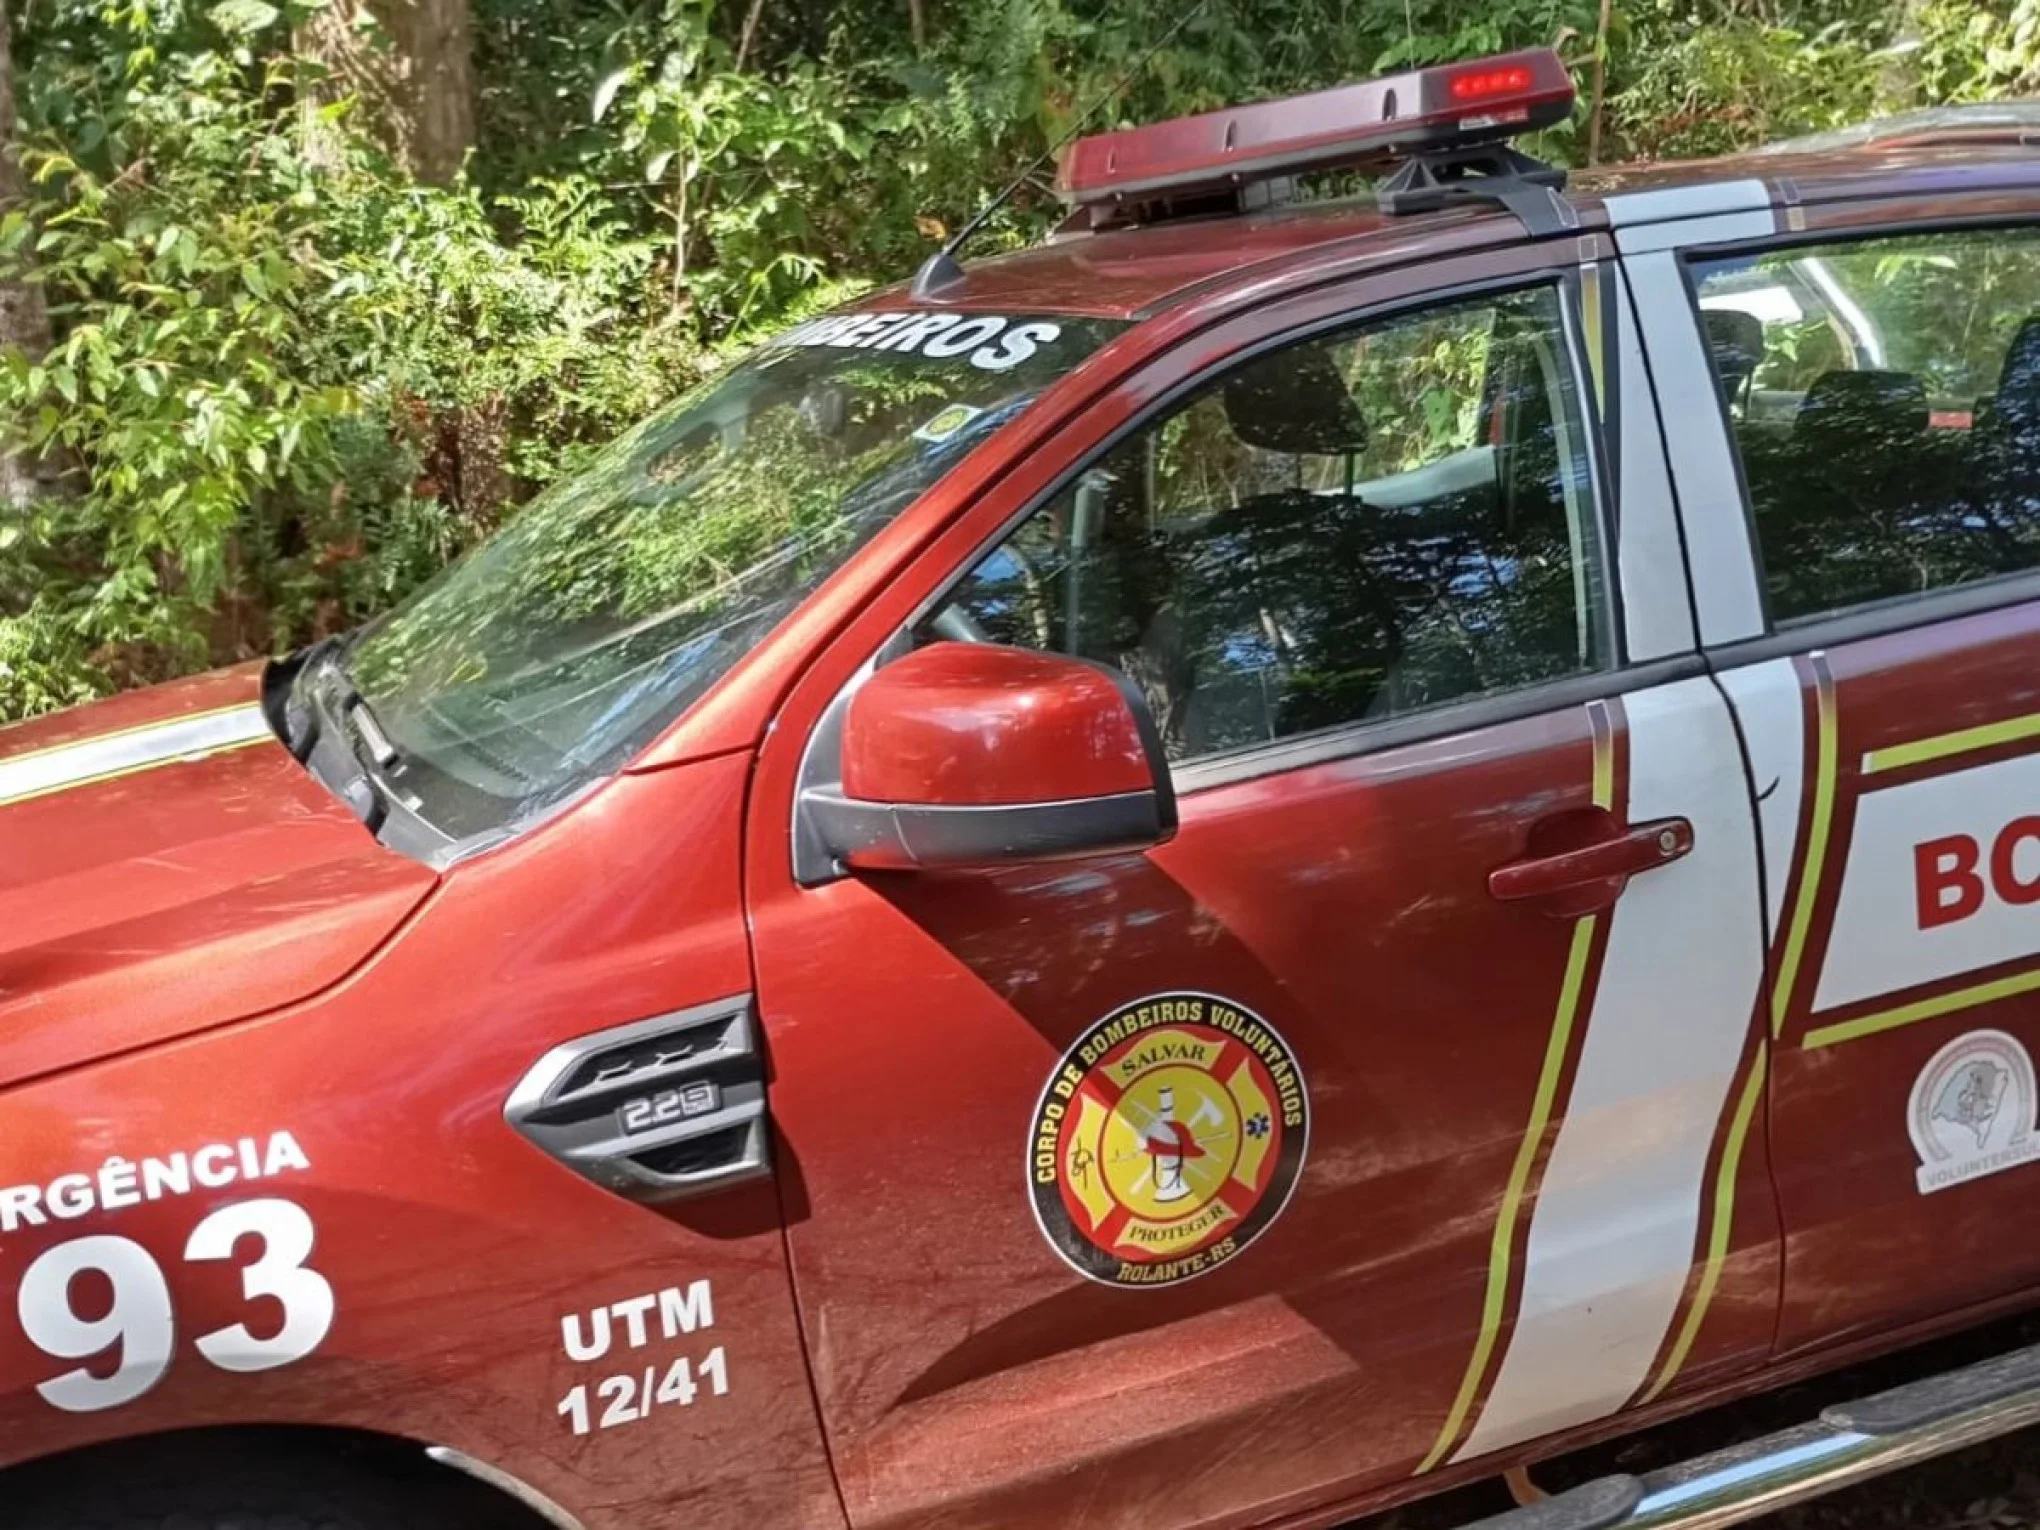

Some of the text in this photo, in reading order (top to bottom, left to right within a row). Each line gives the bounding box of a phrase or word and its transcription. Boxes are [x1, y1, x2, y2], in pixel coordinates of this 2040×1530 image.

[1037, 1002, 1301, 1183] CORPO DE BOMBEIROS VOLUNTÁRIOS
[1122, 1043, 1207, 1077] SALVAR
[0, 1130, 310, 1231] RGÊNCIA
[1130, 1205, 1225, 1241] PROTEGER
[1117, 1236, 1237, 1281] ROLANTE-RS
[17, 1198, 334, 1412] 93
[561, 1279, 714, 1361] UTM
[557, 1346, 729, 1435] 12/41
